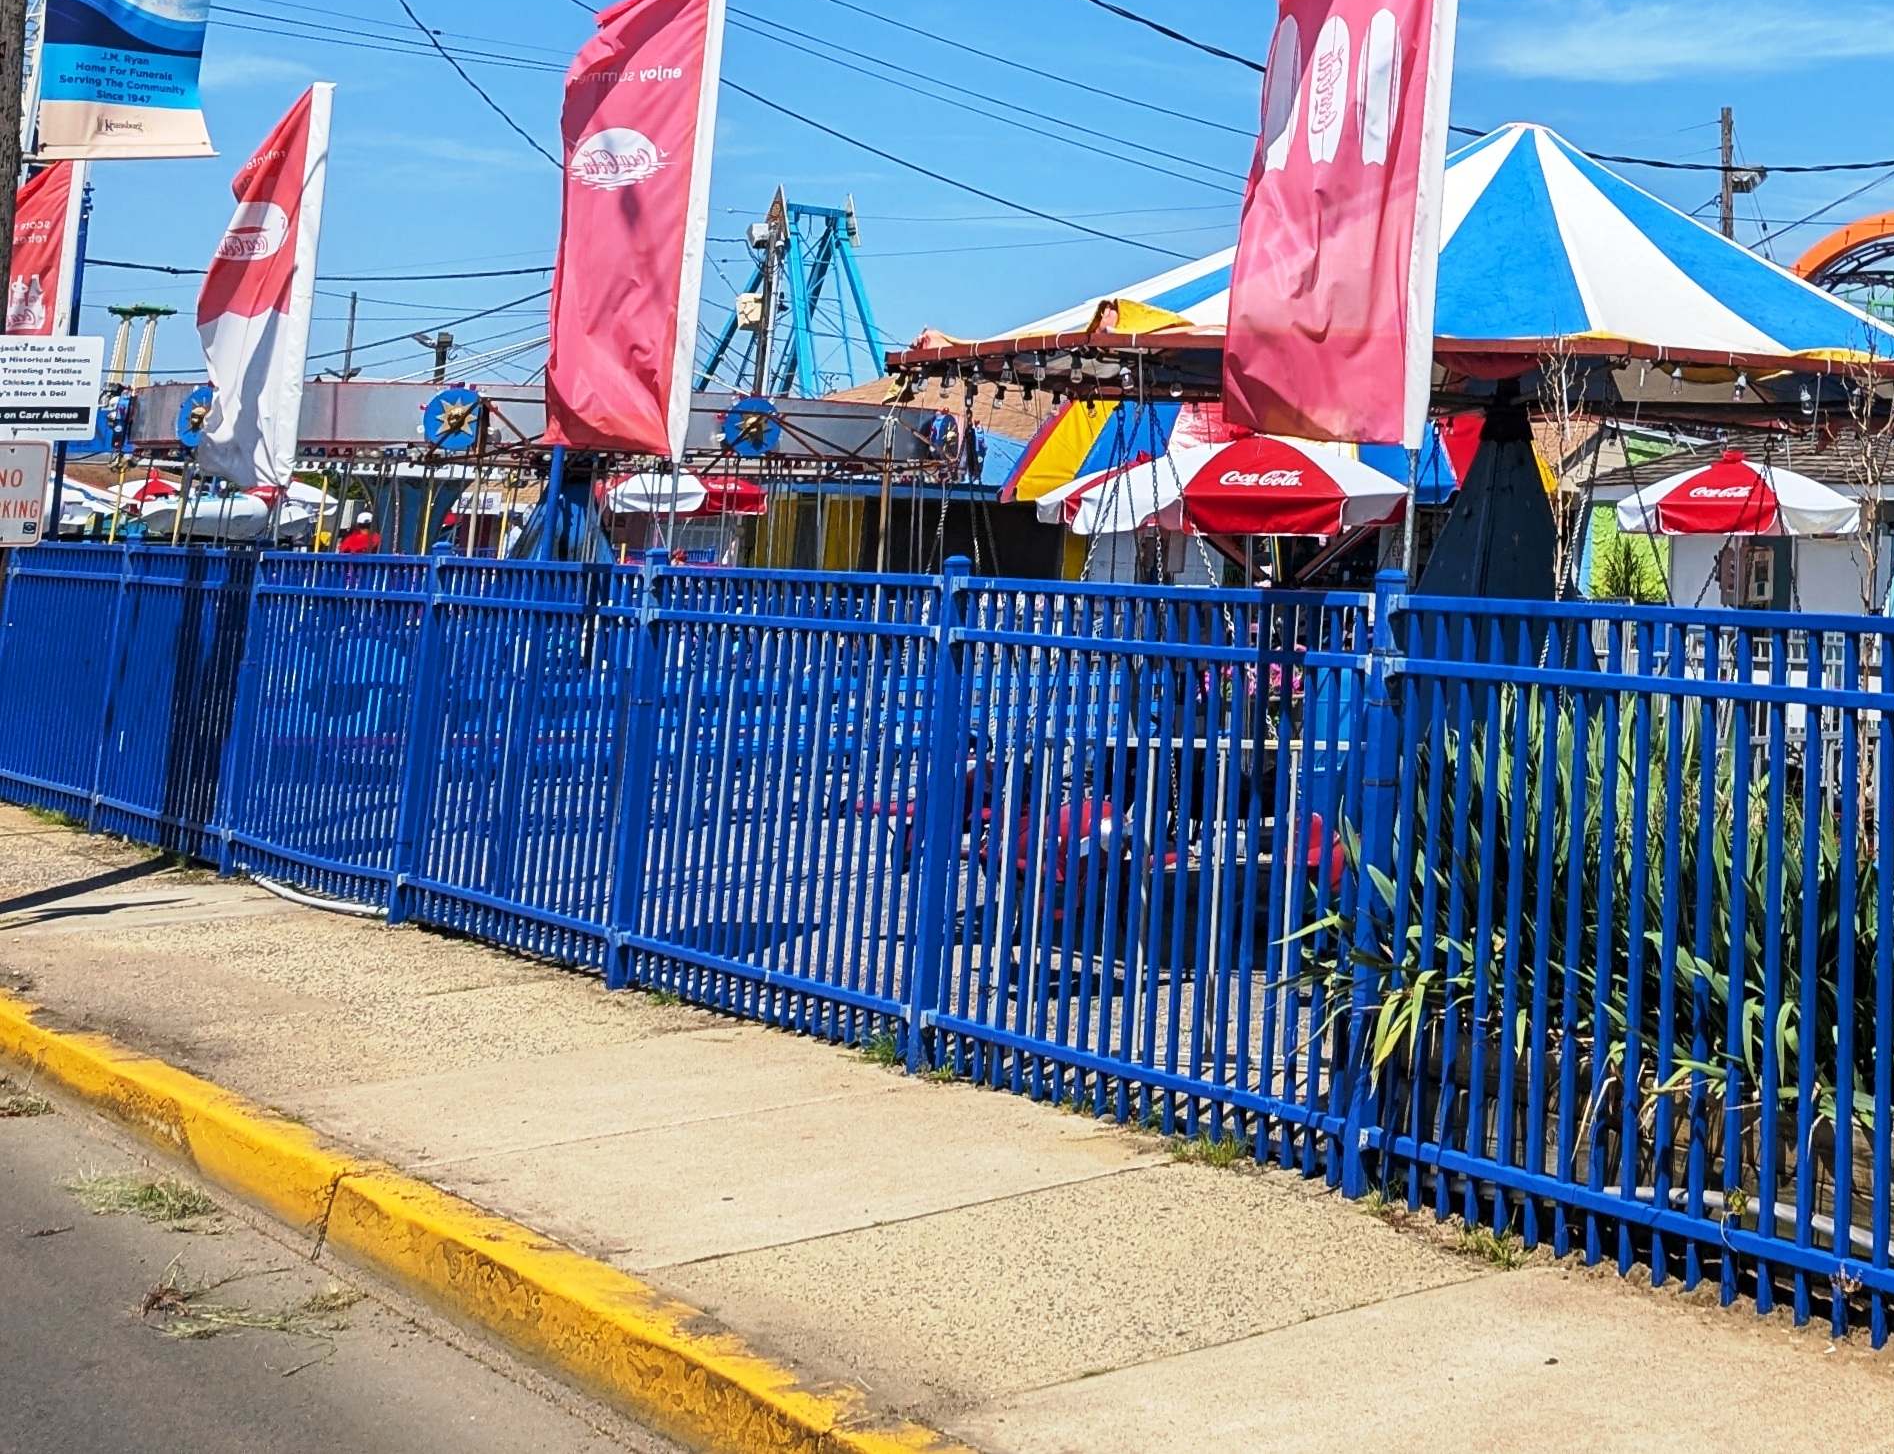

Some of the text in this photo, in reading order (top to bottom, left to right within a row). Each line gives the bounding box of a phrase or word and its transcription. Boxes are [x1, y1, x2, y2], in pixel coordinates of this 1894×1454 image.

[101, 51, 150, 66] J.M. Ryan
[76, 61, 173, 81] Home For Funerals
[59, 74, 186, 95] Serving The Community
[96, 89, 151, 104] Since 1947
[3, 368, 43, 376] Traveling
[2, 379, 35, 387] Chicken
[19, 410, 40, 419] Carr
[42, 410, 79, 419] Avenue
[1220, 469, 1304, 487] Coca-Cola
